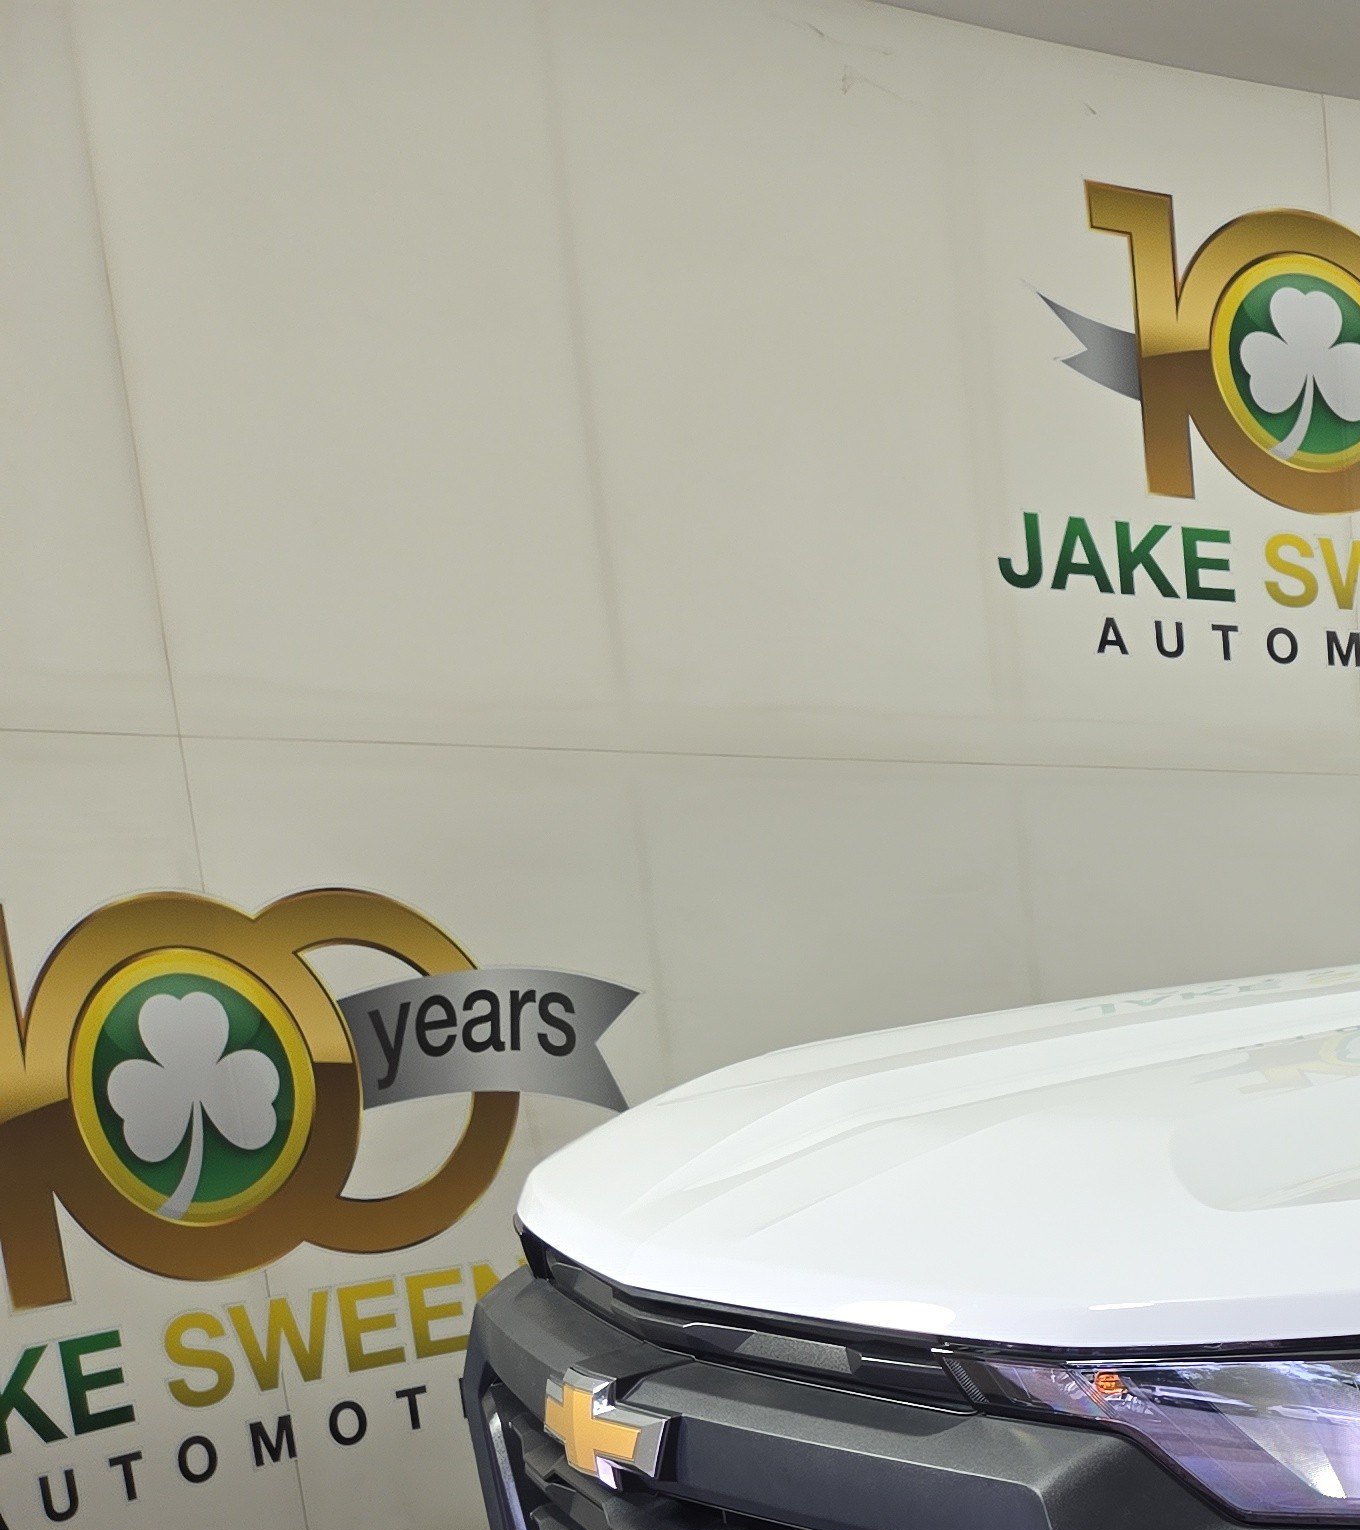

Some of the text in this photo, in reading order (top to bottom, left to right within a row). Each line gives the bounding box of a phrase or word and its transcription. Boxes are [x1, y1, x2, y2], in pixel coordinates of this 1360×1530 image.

[997, 511, 1237, 602] JAKE
[368, 988, 578, 1090] years
[0, 1258, 528, 1456] KE SWEE
